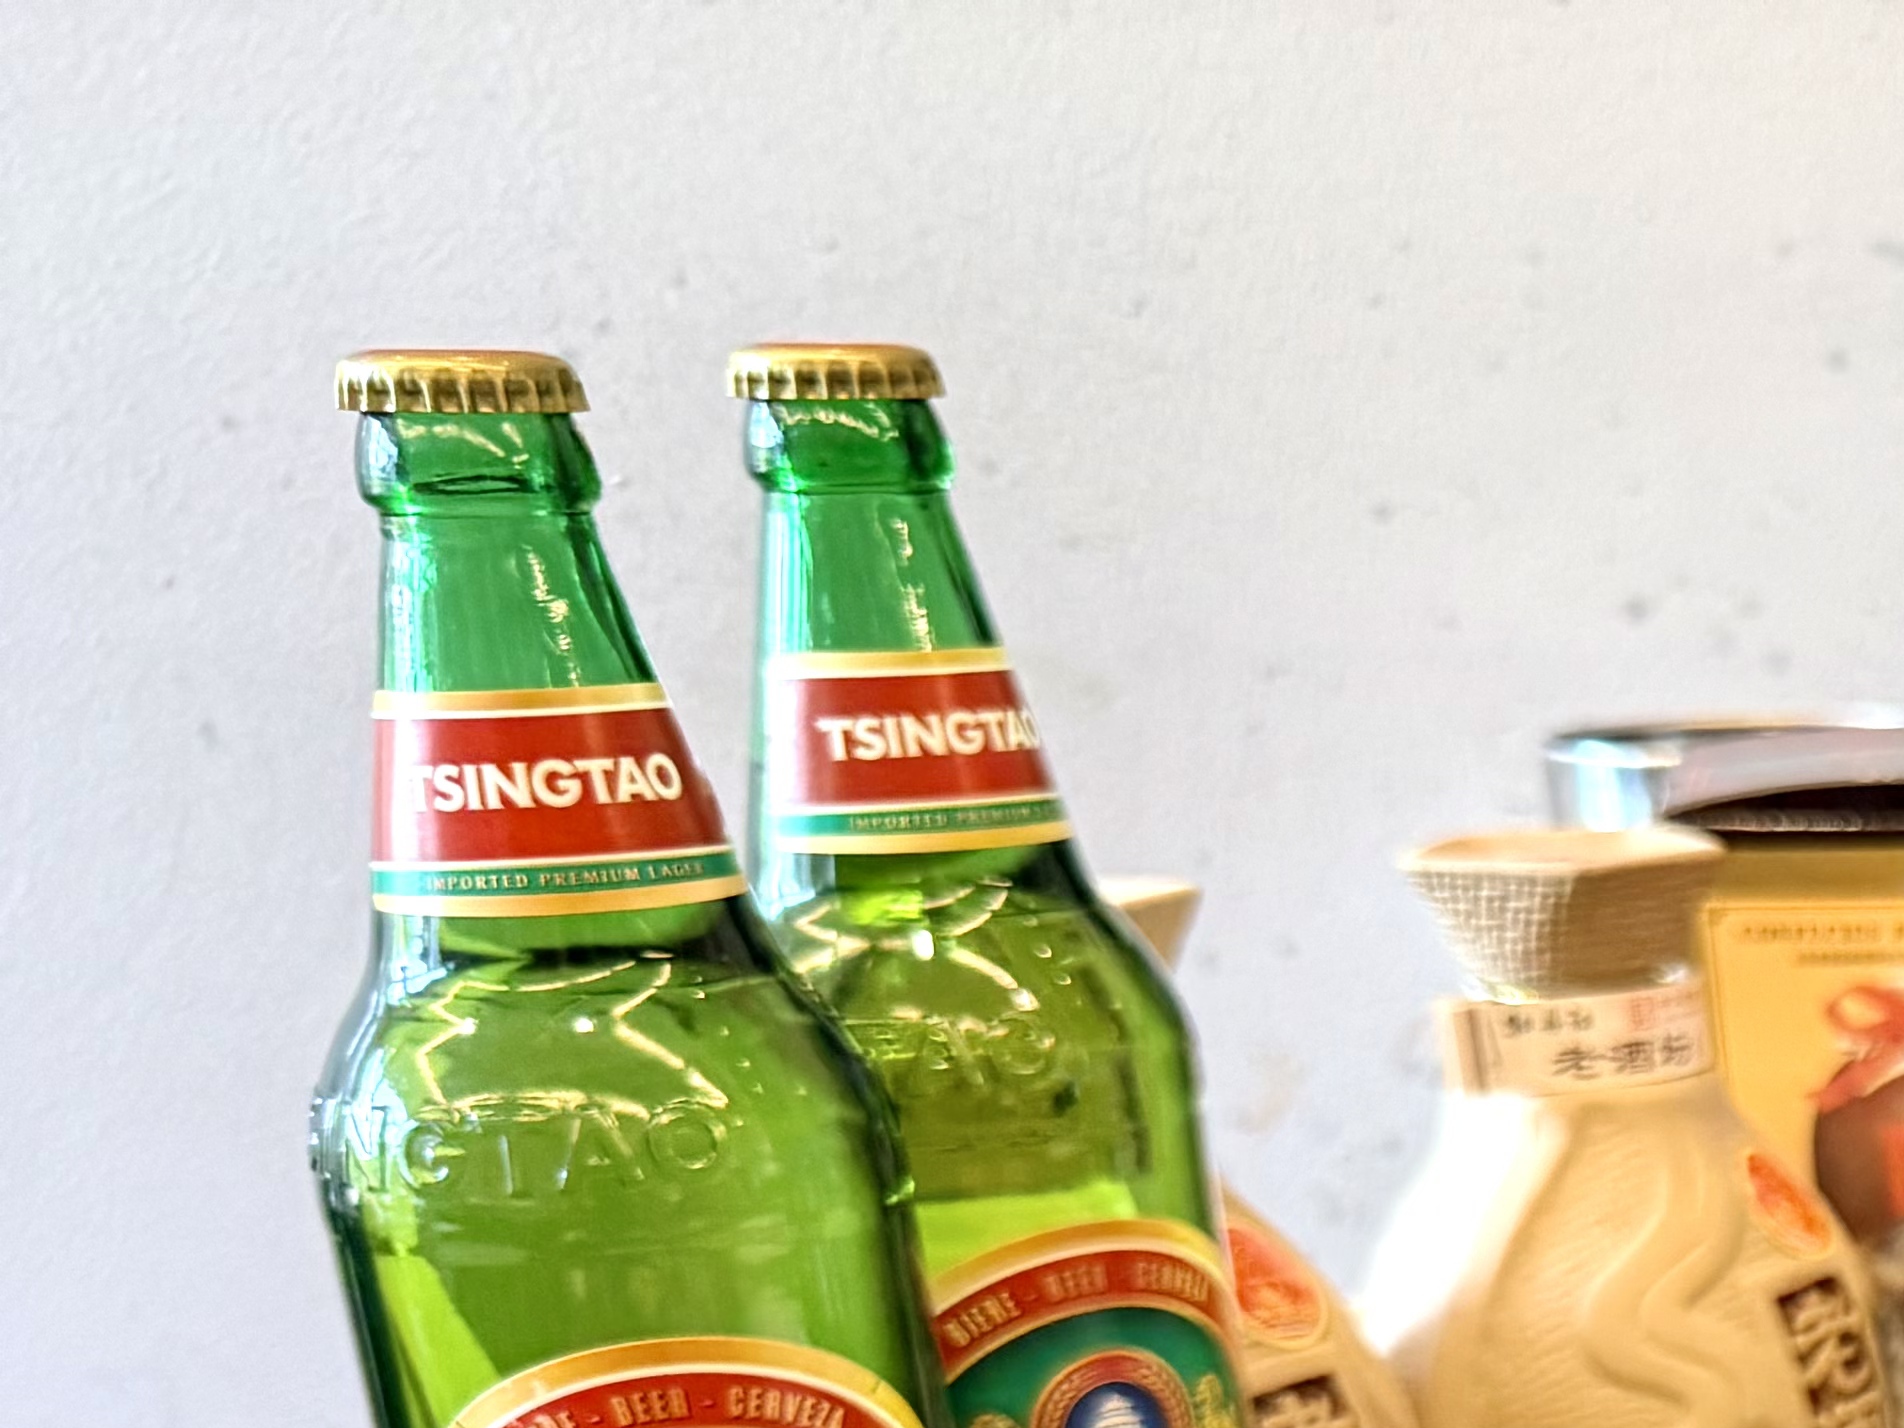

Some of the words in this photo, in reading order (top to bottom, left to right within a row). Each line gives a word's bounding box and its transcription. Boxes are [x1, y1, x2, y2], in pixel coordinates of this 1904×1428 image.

[815, 707, 1042, 761] TSINGTAO
[407, 752, 683, 814] TSINGTAO
[427, 873, 529, 892] IMPORTED
[538, 866, 640, 888] PREMIUM
[648, 861, 706, 880] LAGER
[610, 1386, 692, 1428] BEER
